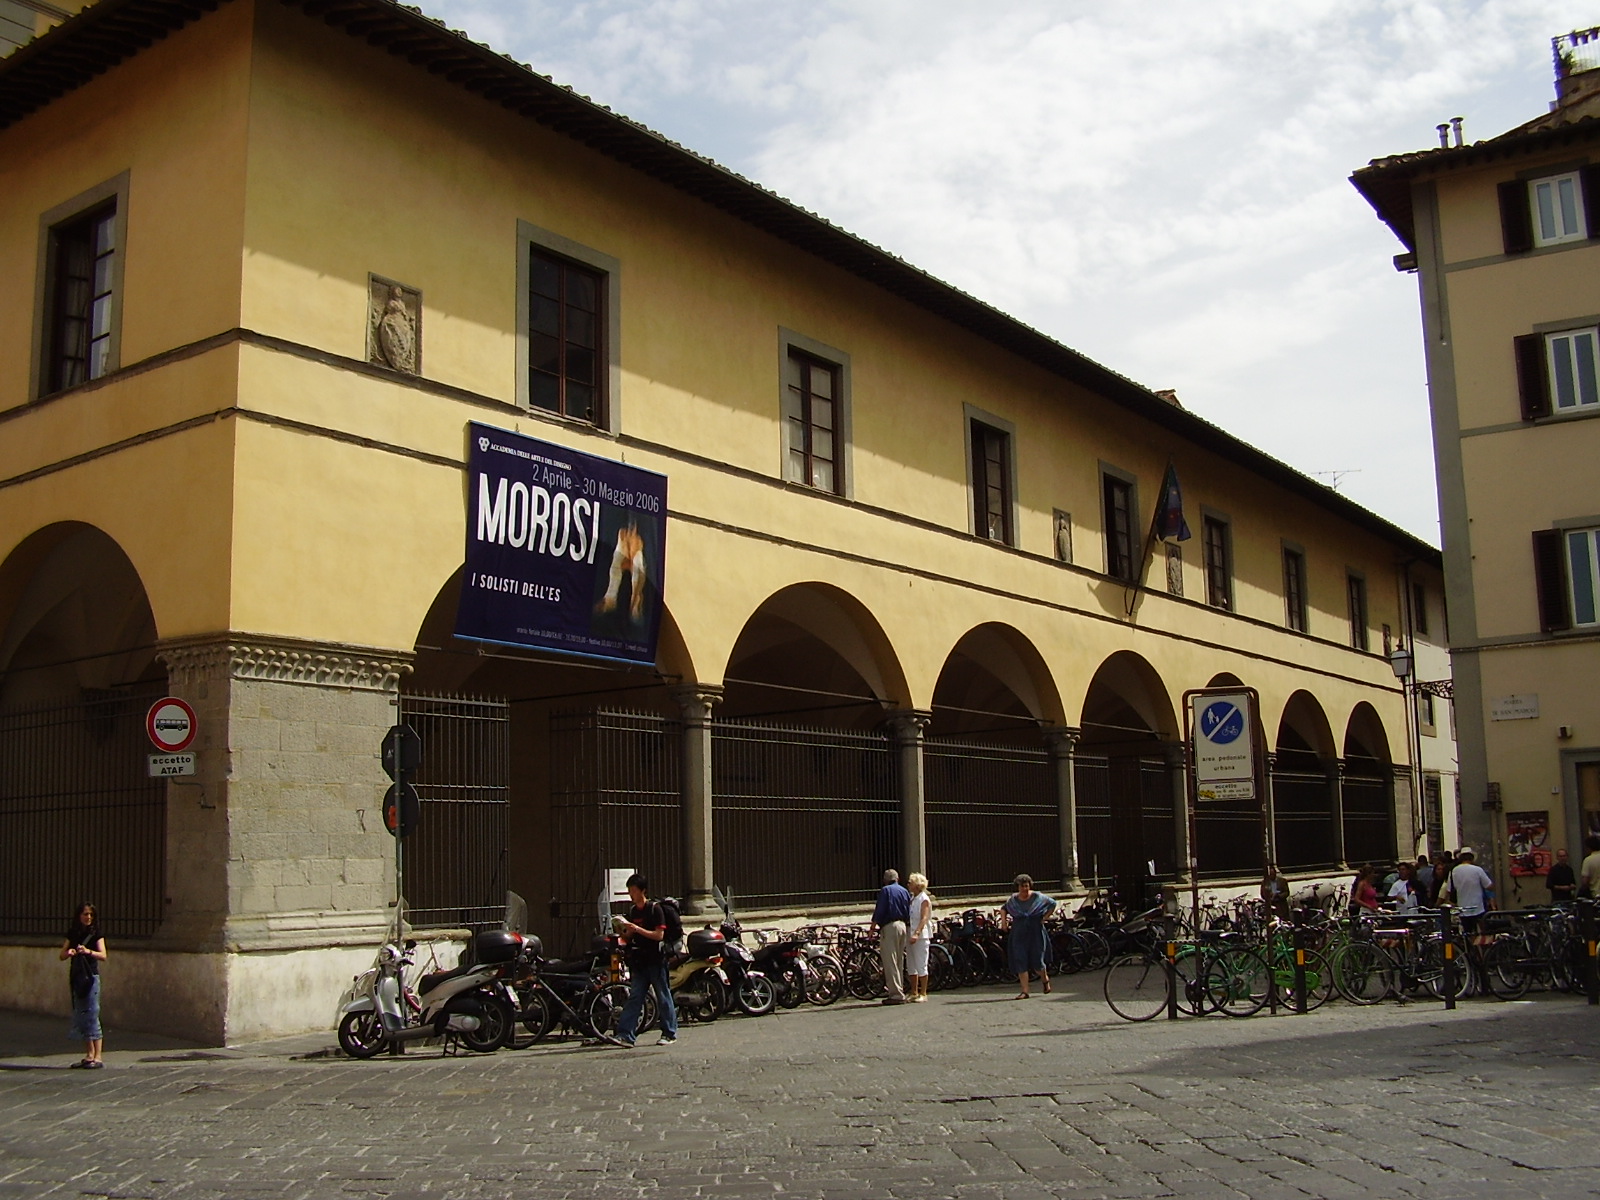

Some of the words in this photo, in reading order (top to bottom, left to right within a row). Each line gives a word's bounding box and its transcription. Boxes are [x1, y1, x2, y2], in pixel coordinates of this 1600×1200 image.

[532, 463, 541, 482] 2
[542, 467, 572, 491] Aprile
[582, 476, 596, 497] 30
[598, 480, 634, 508] Maggio
[635, 491, 660, 513] 2006
[477, 472, 600, 565] MOROSI
[471, 571, 478, 587] I
[479, 573, 520, 595] SOLISTI
[521, 581, 562, 603] DELL'ES
[152, 756, 191, 764] eccetto
[160, 766, 184, 774] ATAF
